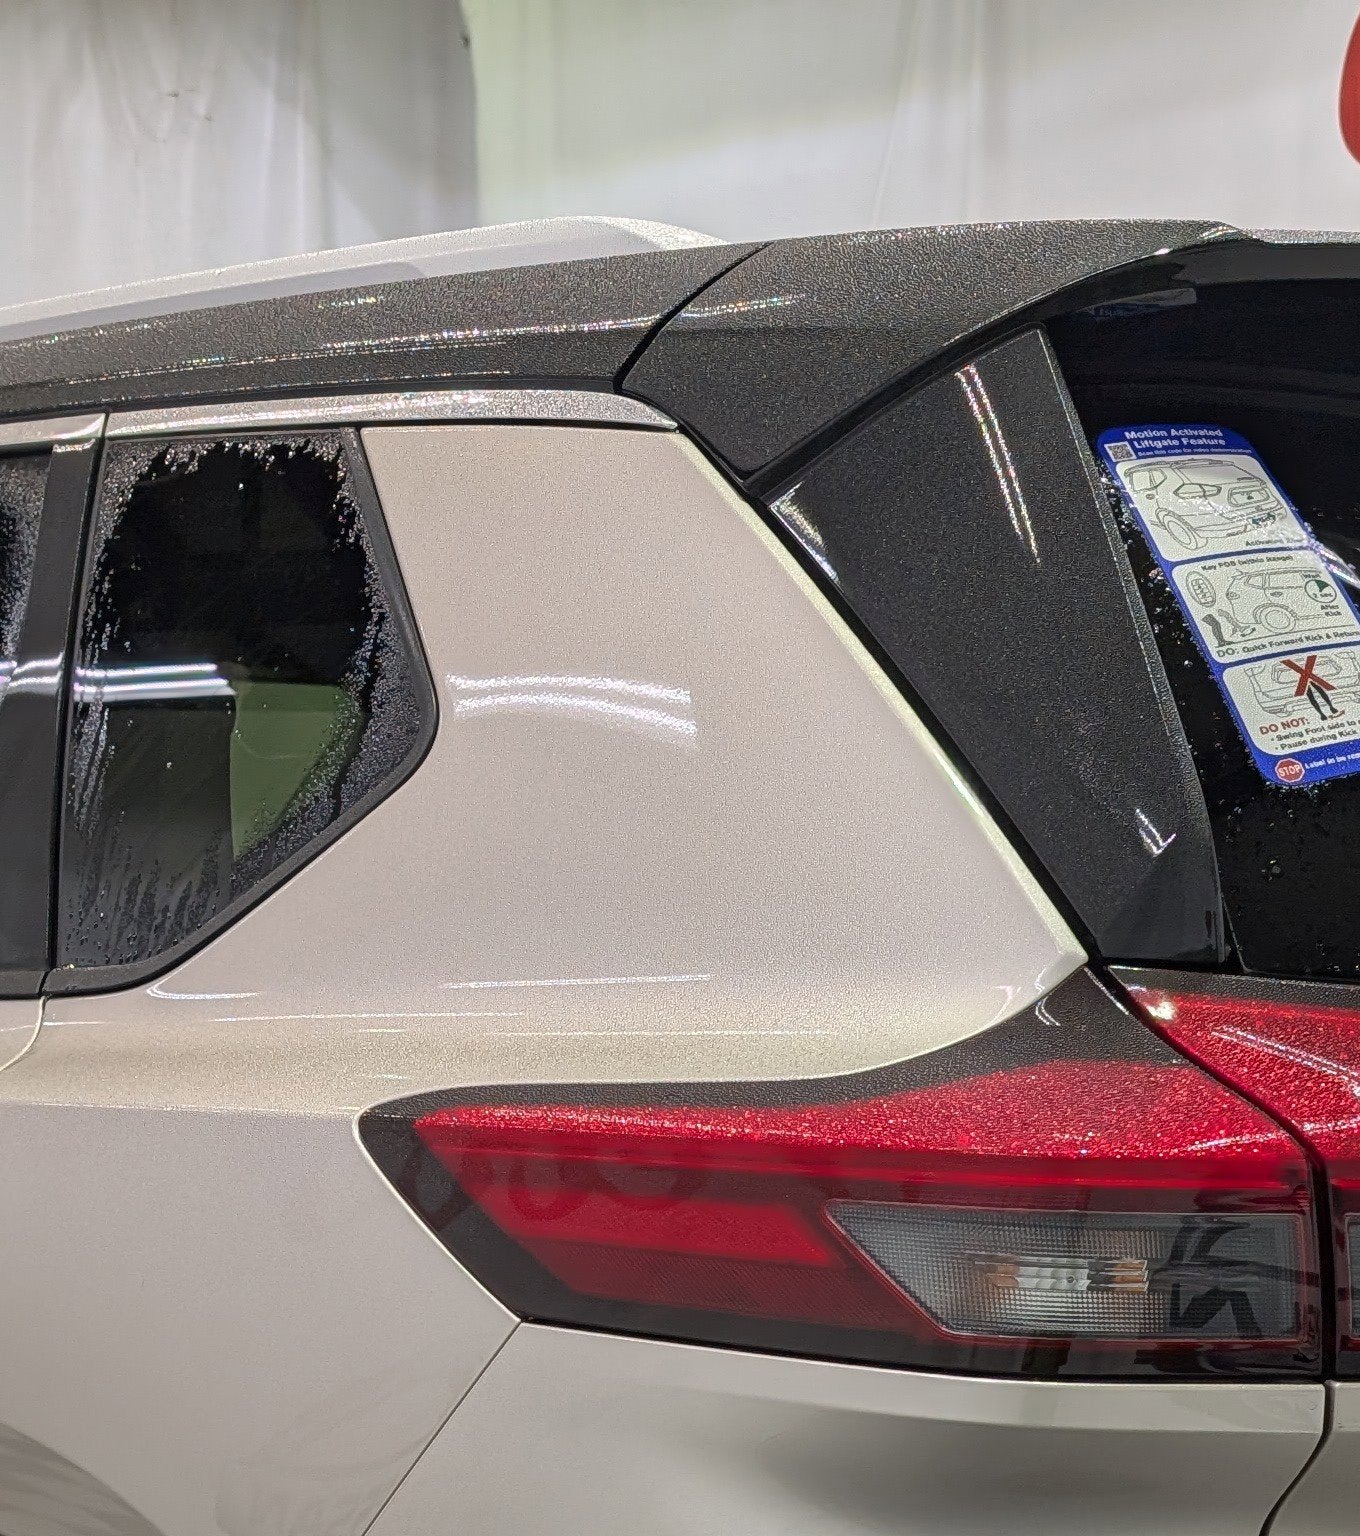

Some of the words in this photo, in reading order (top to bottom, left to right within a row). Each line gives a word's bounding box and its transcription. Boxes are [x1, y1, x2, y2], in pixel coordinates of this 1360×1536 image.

[1124, 430, 1168, 439] Motion
[1170, 428, 1223, 437] Activated
[1132, 439, 1180, 448] Liftgate
[1181, 437, 1225, 445] Feature
[1217, 647, 1240, 657] DO:
[1242, 643, 1267, 653] Quick
[1269, 637, 1304, 648] Forward
[1305, 633, 1324, 641] Kick
[1332, 629, 1360, 638] Return
[1259, 723, 1279, 735] DO
[1280, 716, 1310, 730] NOT:
[1276, 731, 1304, 742] Swing
[1305, 726, 1326, 735] Foot
[1327, 721, 1346, 730] side
[1280, 739, 1308, 750] Pause
[1310, 732, 1338, 744] during
[1338, 729, 1358, 738] Kick
[1278, 765, 1301, 777] STOP
